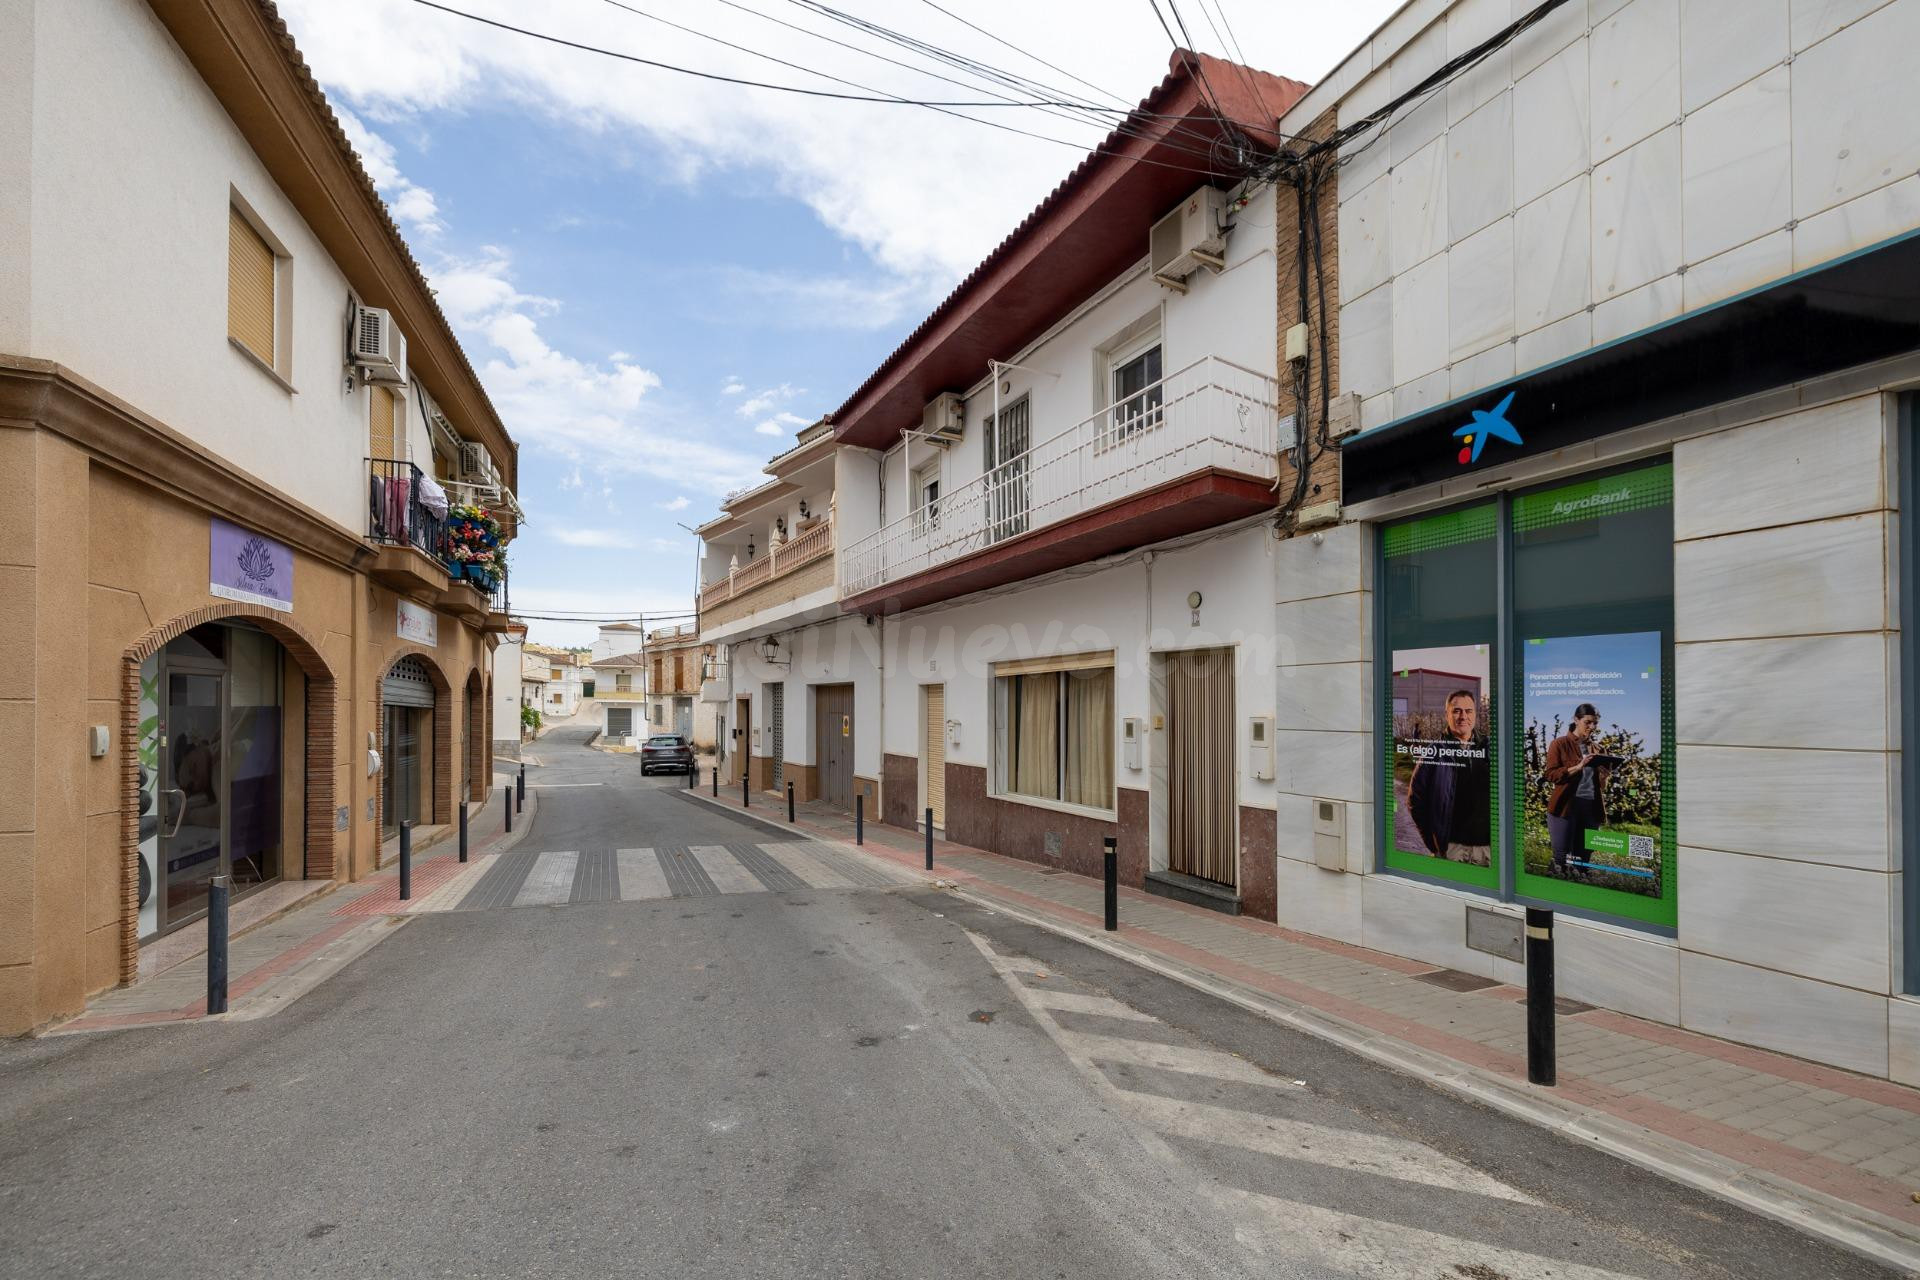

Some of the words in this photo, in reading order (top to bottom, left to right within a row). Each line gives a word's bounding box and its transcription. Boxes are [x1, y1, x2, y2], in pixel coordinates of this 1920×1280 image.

[1551, 487, 1632, 515] AgroBank
[1529, 673, 1563, 681] Ponemos
[1579, 671, 1623, 681] disposición
[1567, 680, 1600, 689] digitales
[1397, 744, 1408, 754] Es
[1409, 744, 1437, 757] (algo)
[1439, 748, 1486, 759] personal
